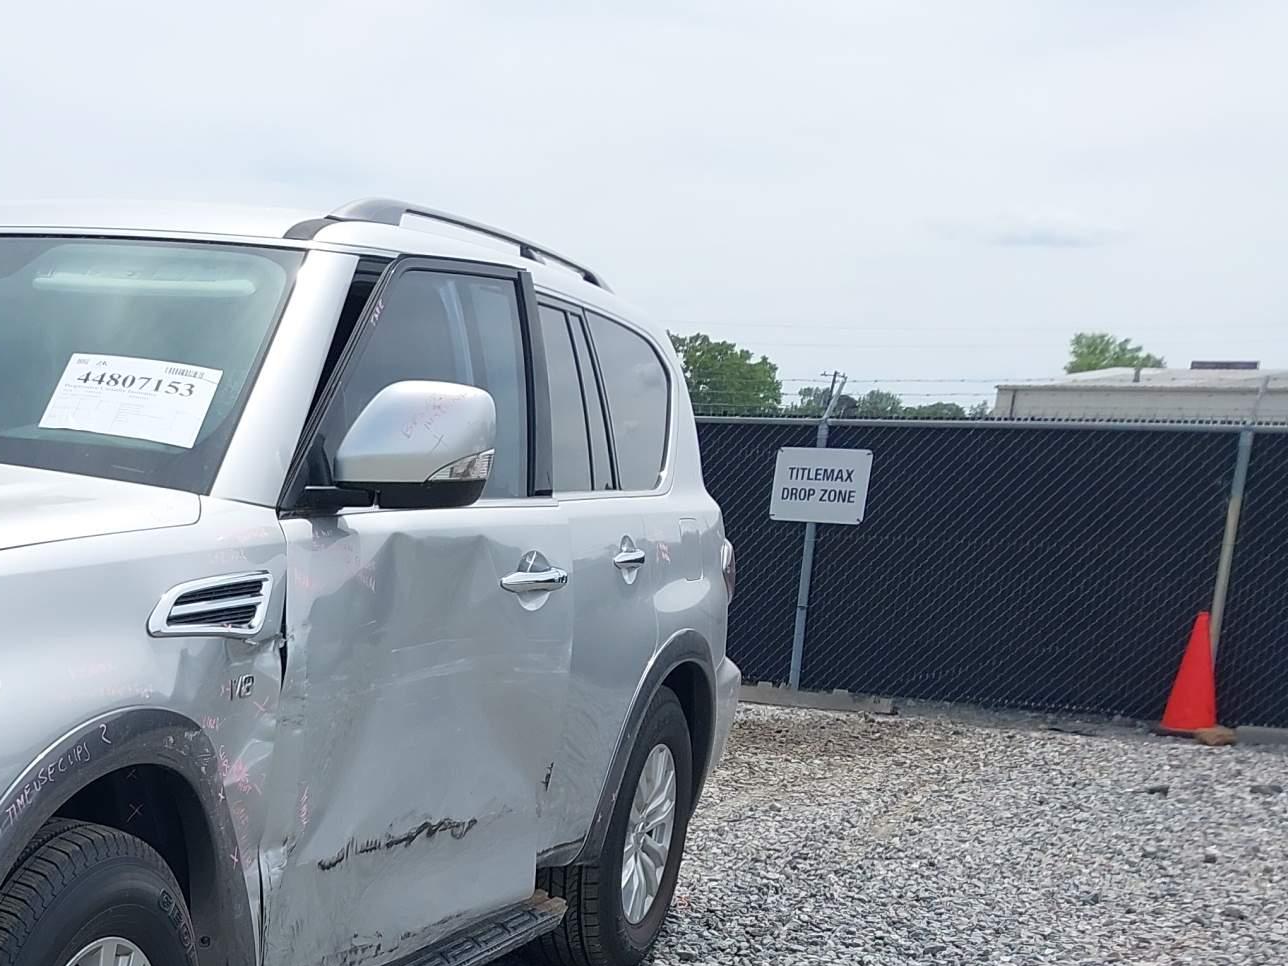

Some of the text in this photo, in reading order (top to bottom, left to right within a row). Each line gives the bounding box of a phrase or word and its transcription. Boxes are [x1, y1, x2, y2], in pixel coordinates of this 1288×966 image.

[77, 370, 195, 397] 44807153
[788, 467, 855, 482] TITLEMAX
[781, 487, 856, 503] DROP ZONE
